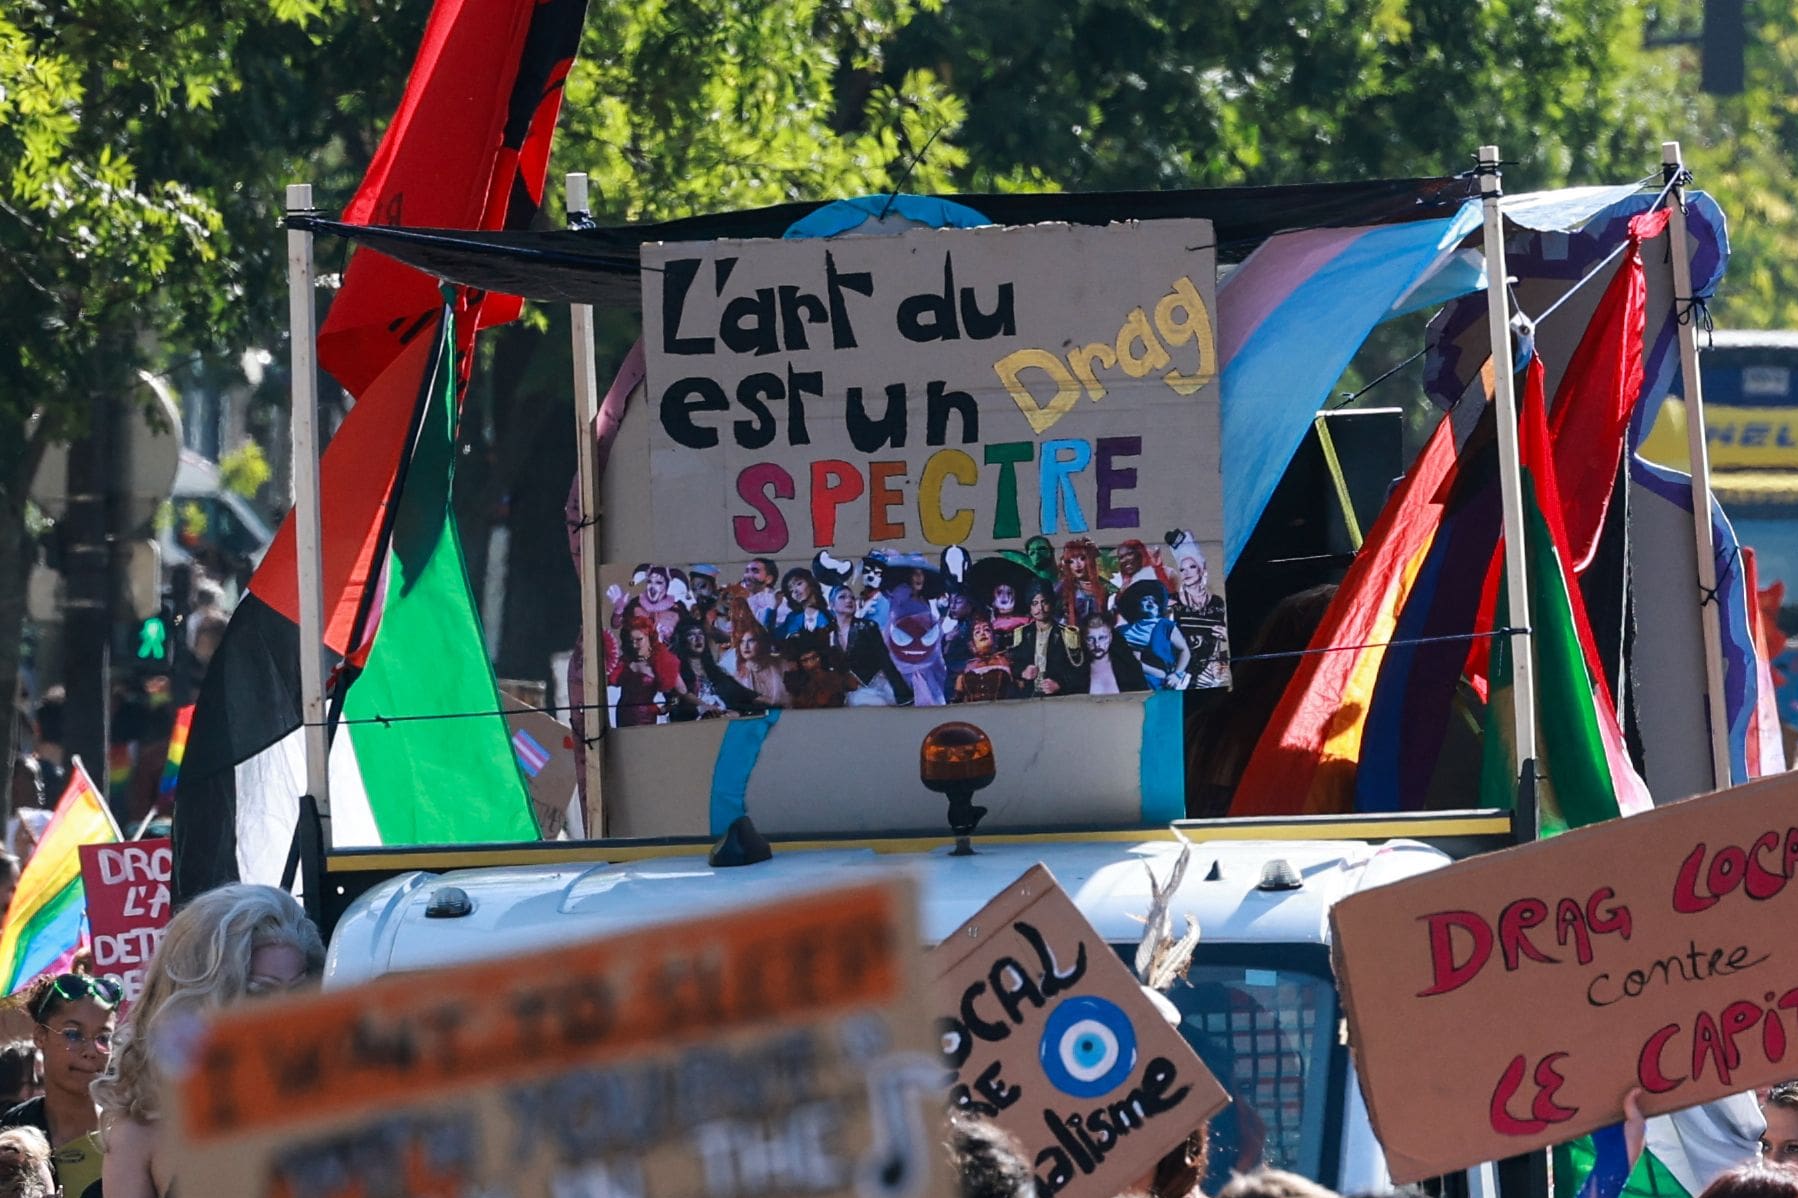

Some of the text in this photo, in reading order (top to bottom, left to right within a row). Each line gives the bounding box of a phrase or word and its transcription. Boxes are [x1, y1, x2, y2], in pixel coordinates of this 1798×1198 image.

[661, 251, 1017, 356] L'art du
[993, 275, 1216, 435] Drag
[660, 360, 979, 454] est un
[733, 435, 1143, 554] SPECTRE
[1416, 885, 1632, 998] DRAG
[1586, 941, 1771, 1007] contre
[1490, 1051, 1579, 1136] LE
[690, 1103, 848, 1197] THE
